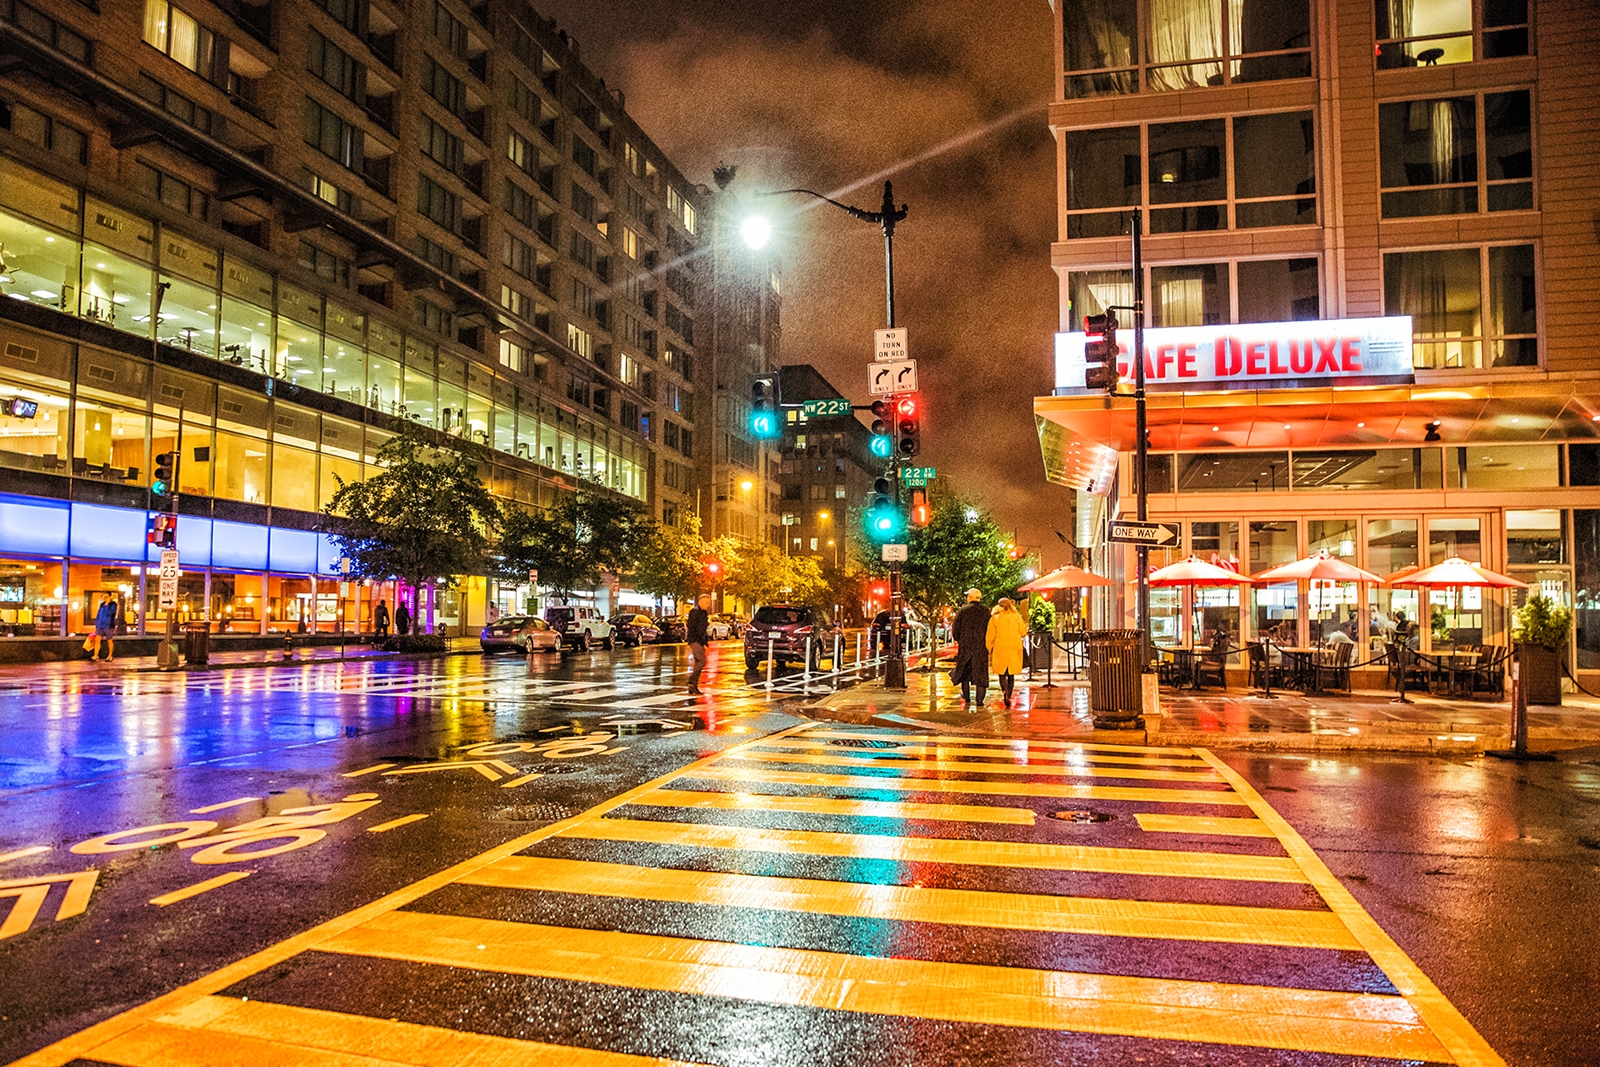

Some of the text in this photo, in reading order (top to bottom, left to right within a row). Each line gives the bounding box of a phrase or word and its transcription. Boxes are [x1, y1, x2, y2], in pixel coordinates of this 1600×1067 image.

[882, 341, 901, 349] TURN
[1116, 334, 1364, 380] CAFE DELUXE
[804, 401, 849, 415] NW 22 ST
[905, 468, 921, 478] 22
[1115, 527, 1157, 538] ONE WAY
[163, 565, 176, 577] 25
[162, 582, 175, 590] ONE
